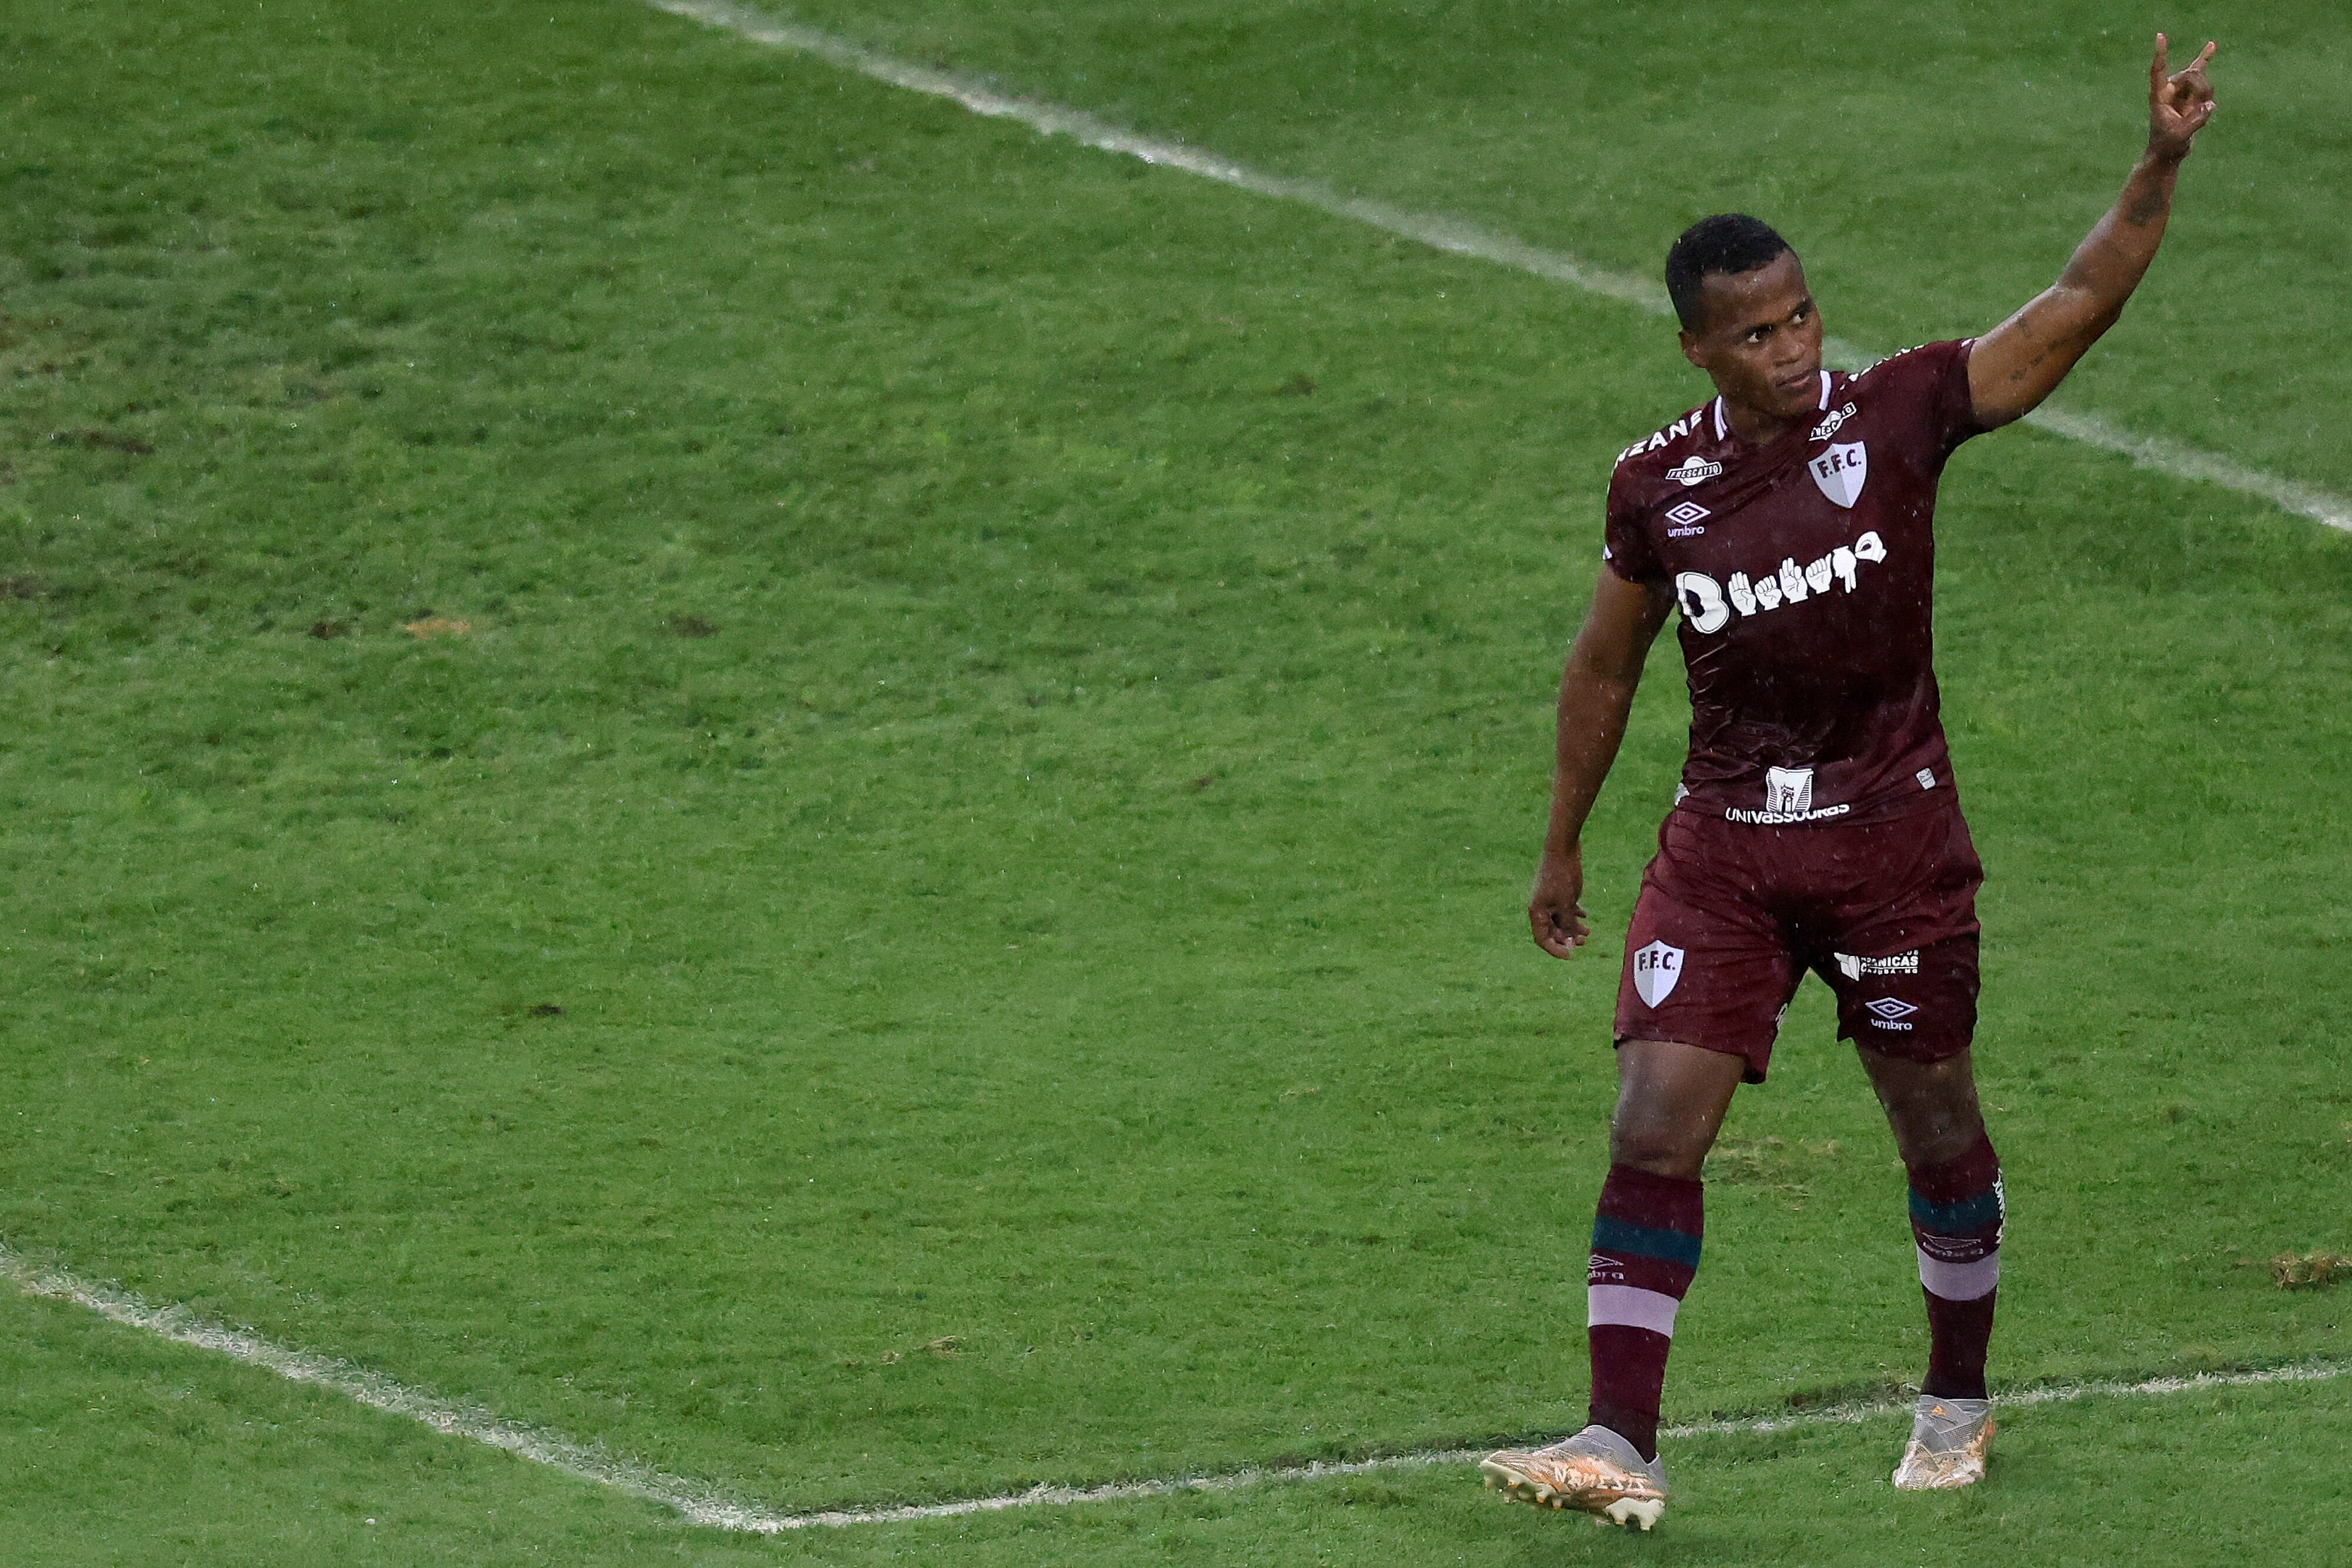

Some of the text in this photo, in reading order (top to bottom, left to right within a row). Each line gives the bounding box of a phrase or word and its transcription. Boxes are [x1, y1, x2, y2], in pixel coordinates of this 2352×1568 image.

[1670, 463, 1719, 478] FRESCATTO
[1816, 449, 1862, 479] F.F.C.
[1667, 525, 1705, 537] umbro
[1638, 950, 1676, 972] F.F.C.
[1870, 1018, 1912, 1031] umbro
